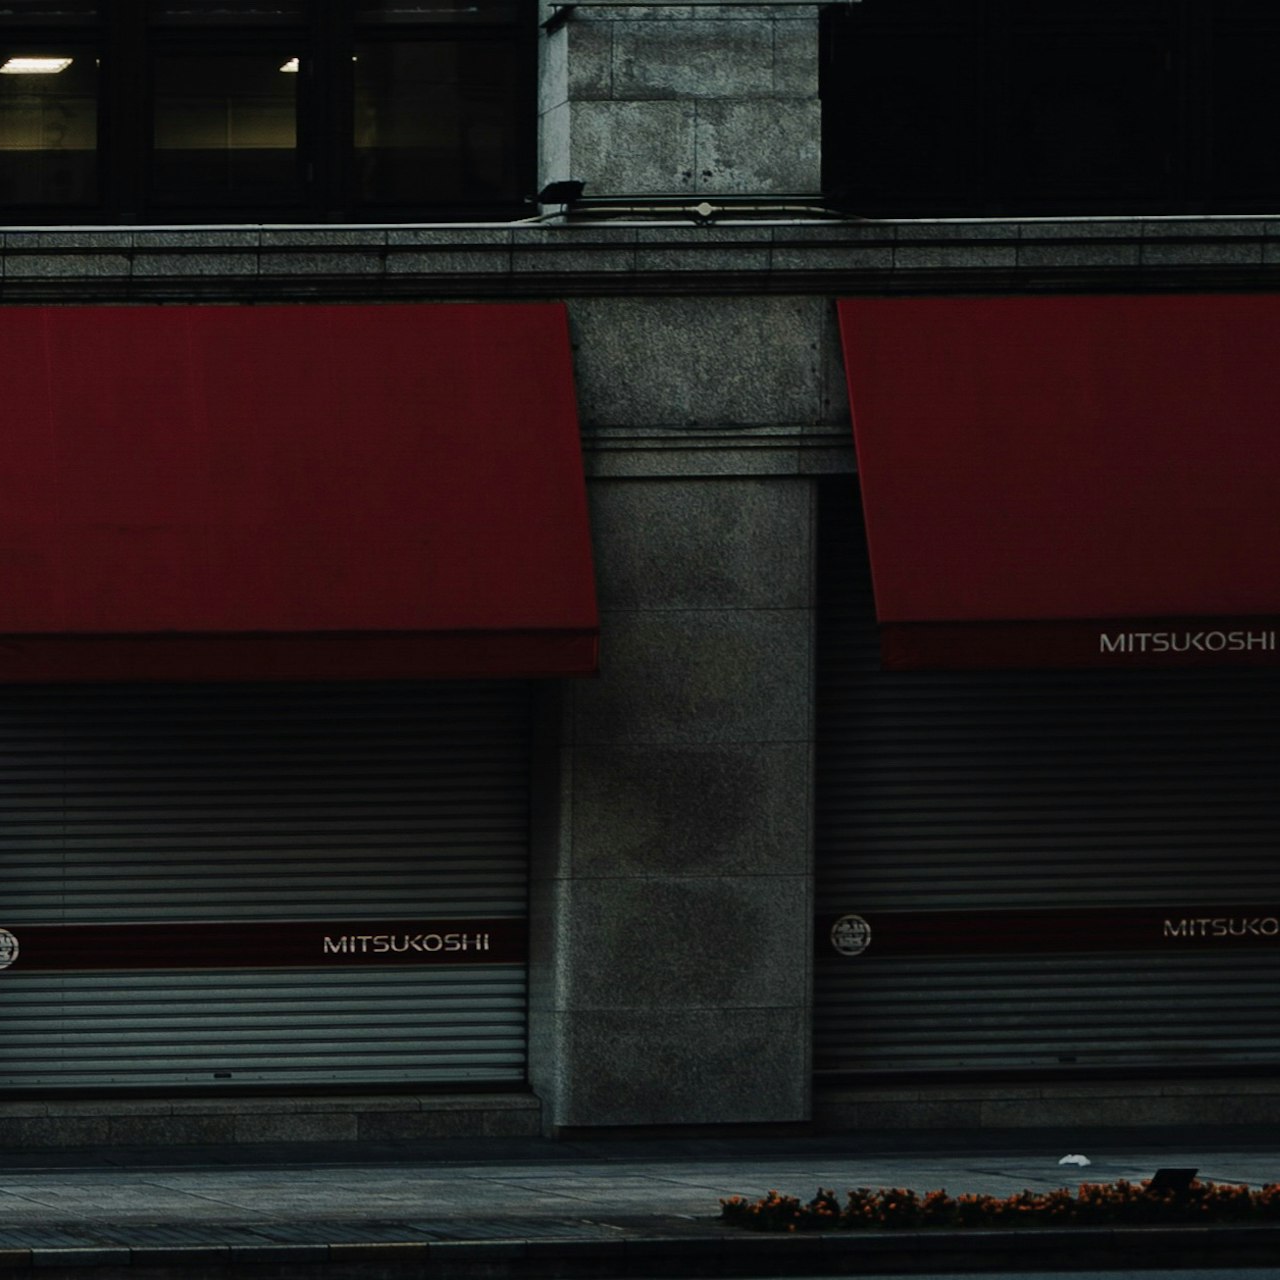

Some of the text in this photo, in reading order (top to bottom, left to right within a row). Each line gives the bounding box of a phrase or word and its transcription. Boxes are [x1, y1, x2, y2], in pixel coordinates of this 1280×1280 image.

[1099, 631, 1276, 653] MITSUKOSHI
[1163, 918, 1280, 937] MITSUKO
[323, 933, 491, 954] MITSUKOSHI
